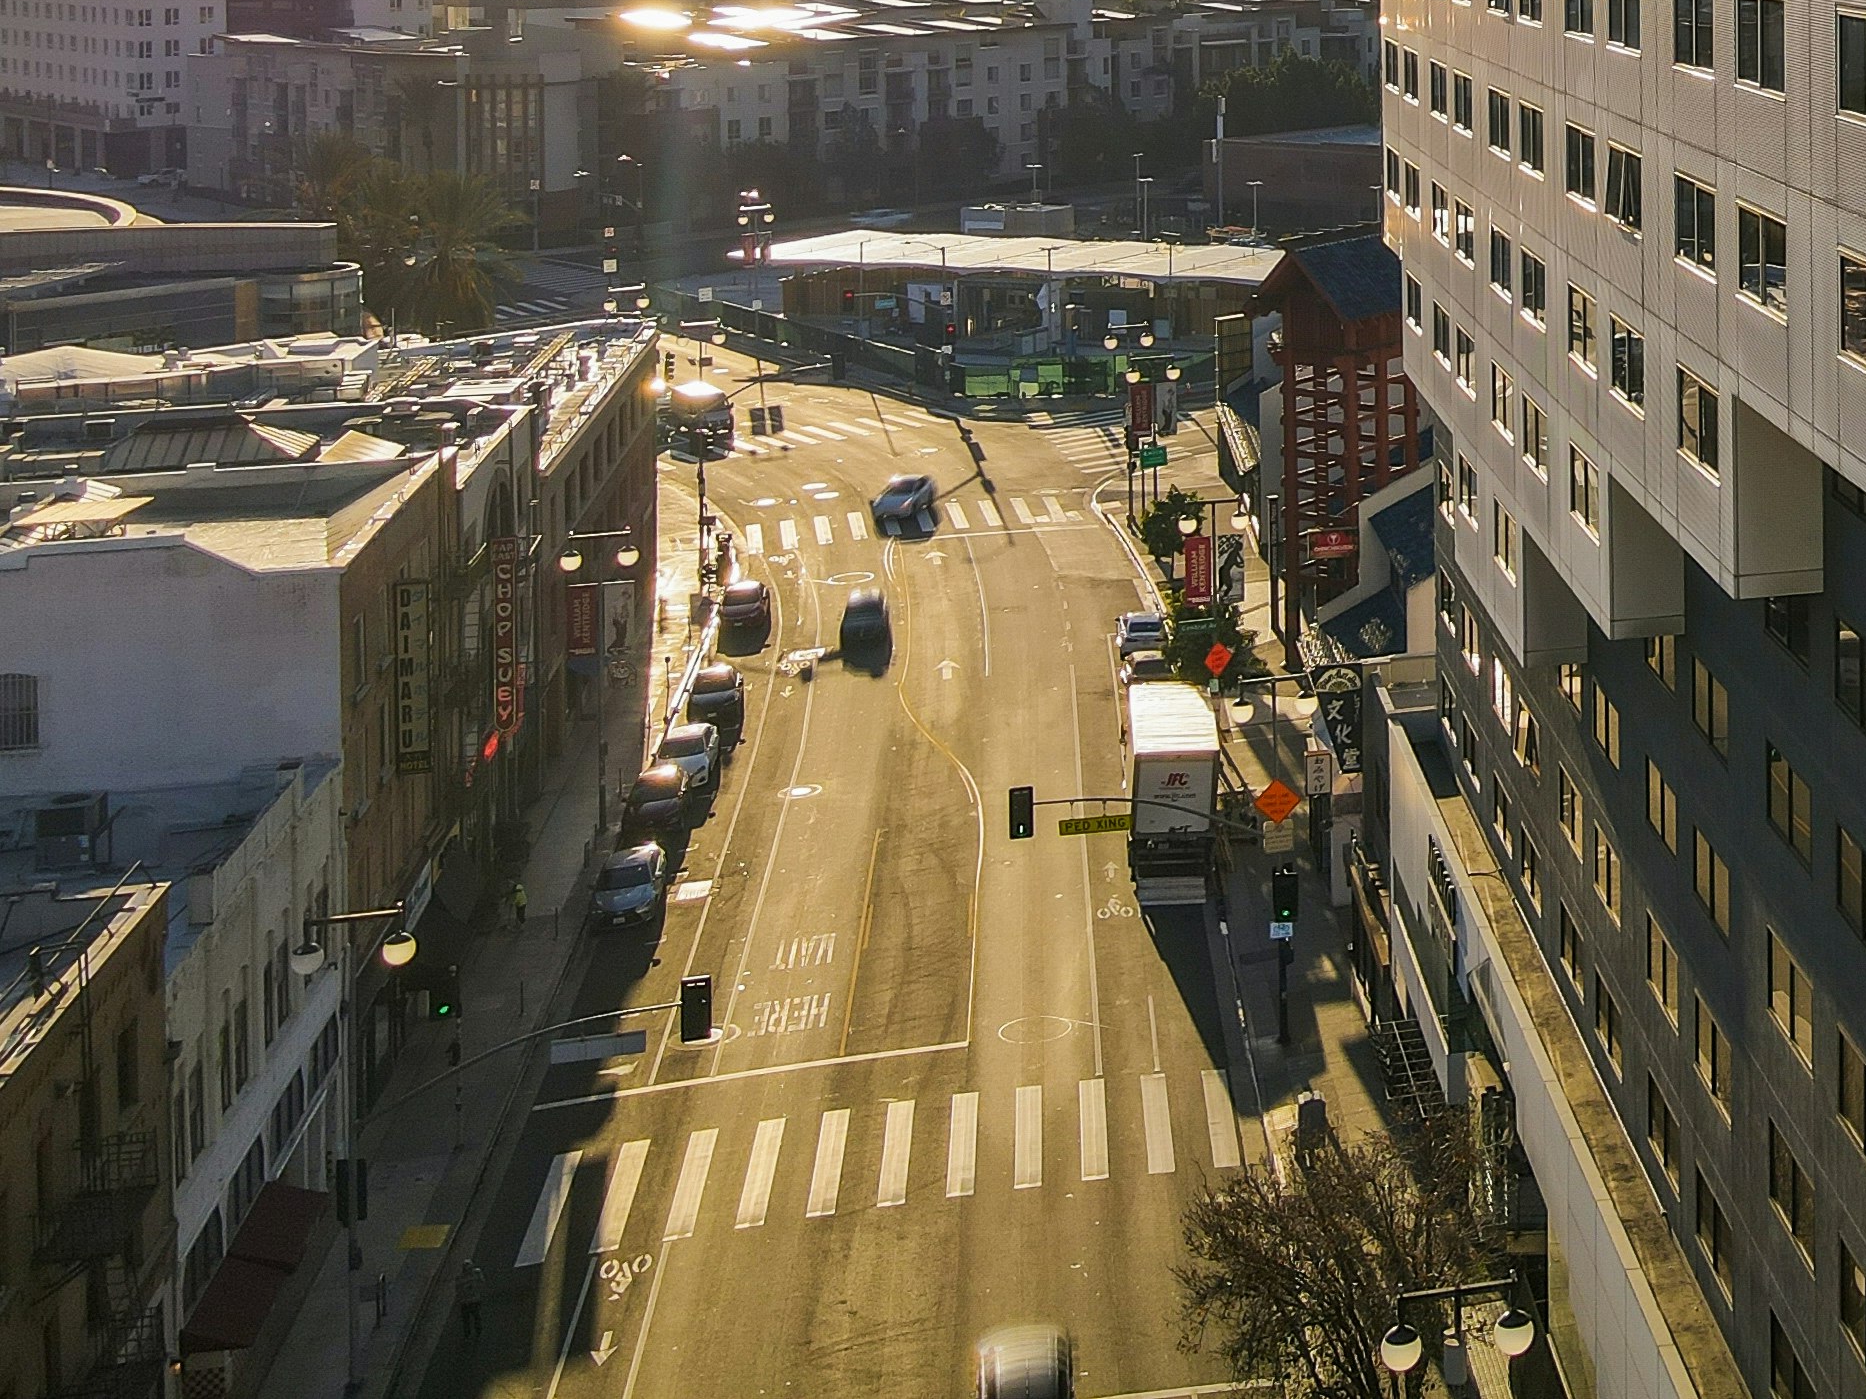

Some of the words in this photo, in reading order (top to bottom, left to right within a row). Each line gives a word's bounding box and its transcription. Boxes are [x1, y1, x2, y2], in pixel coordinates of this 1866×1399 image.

[497, 564, 512, 636] CHOP
[400, 588, 413, 749] DAIMARU
[497, 648, 512, 721] SUEY
[1327, 699, 1361, 770] 文化堂
[1165, 772, 1189, 787] JFC
[1065, 820, 1091, 833] PED
[1095, 817, 1126, 830] XING
[768, 932, 836, 970] WAIT
[747, 992, 832, 1037] HERE
